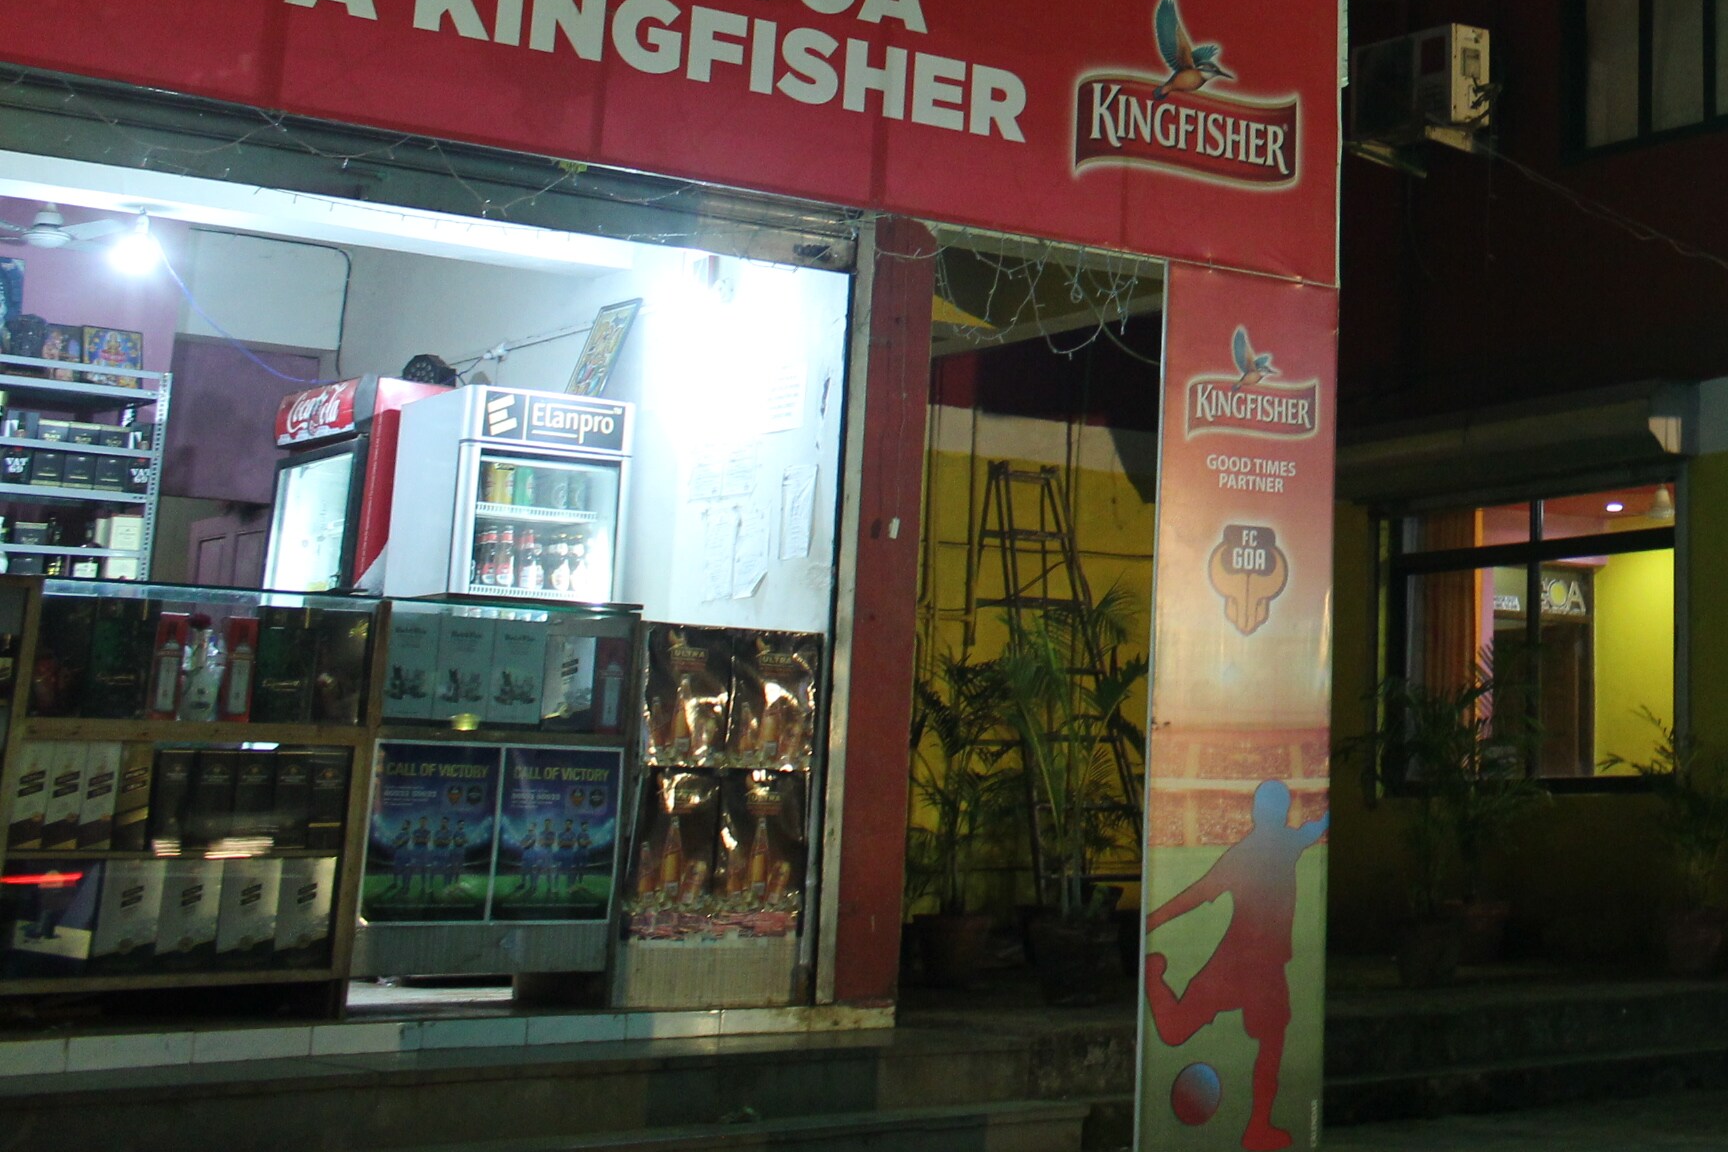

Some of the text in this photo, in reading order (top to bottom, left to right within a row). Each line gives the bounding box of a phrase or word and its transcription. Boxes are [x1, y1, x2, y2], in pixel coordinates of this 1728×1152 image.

[1090, 82, 1290, 175] KINGFISHER
[1195, 383, 1312, 430] KINGFISHER
[531, 401, 615, 444] Elanpro
[1206, 454, 1297, 477] GOOD TIMES
[1218, 473, 1284, 493] PARTNER
[1242, 529, 1258, 547] FC
[1232, 548, 1266, 571] GOA
[386, 762, 490, 778] CALL OF VICTORY
[513, 766, 610, 782] CALL OF VICTORY
